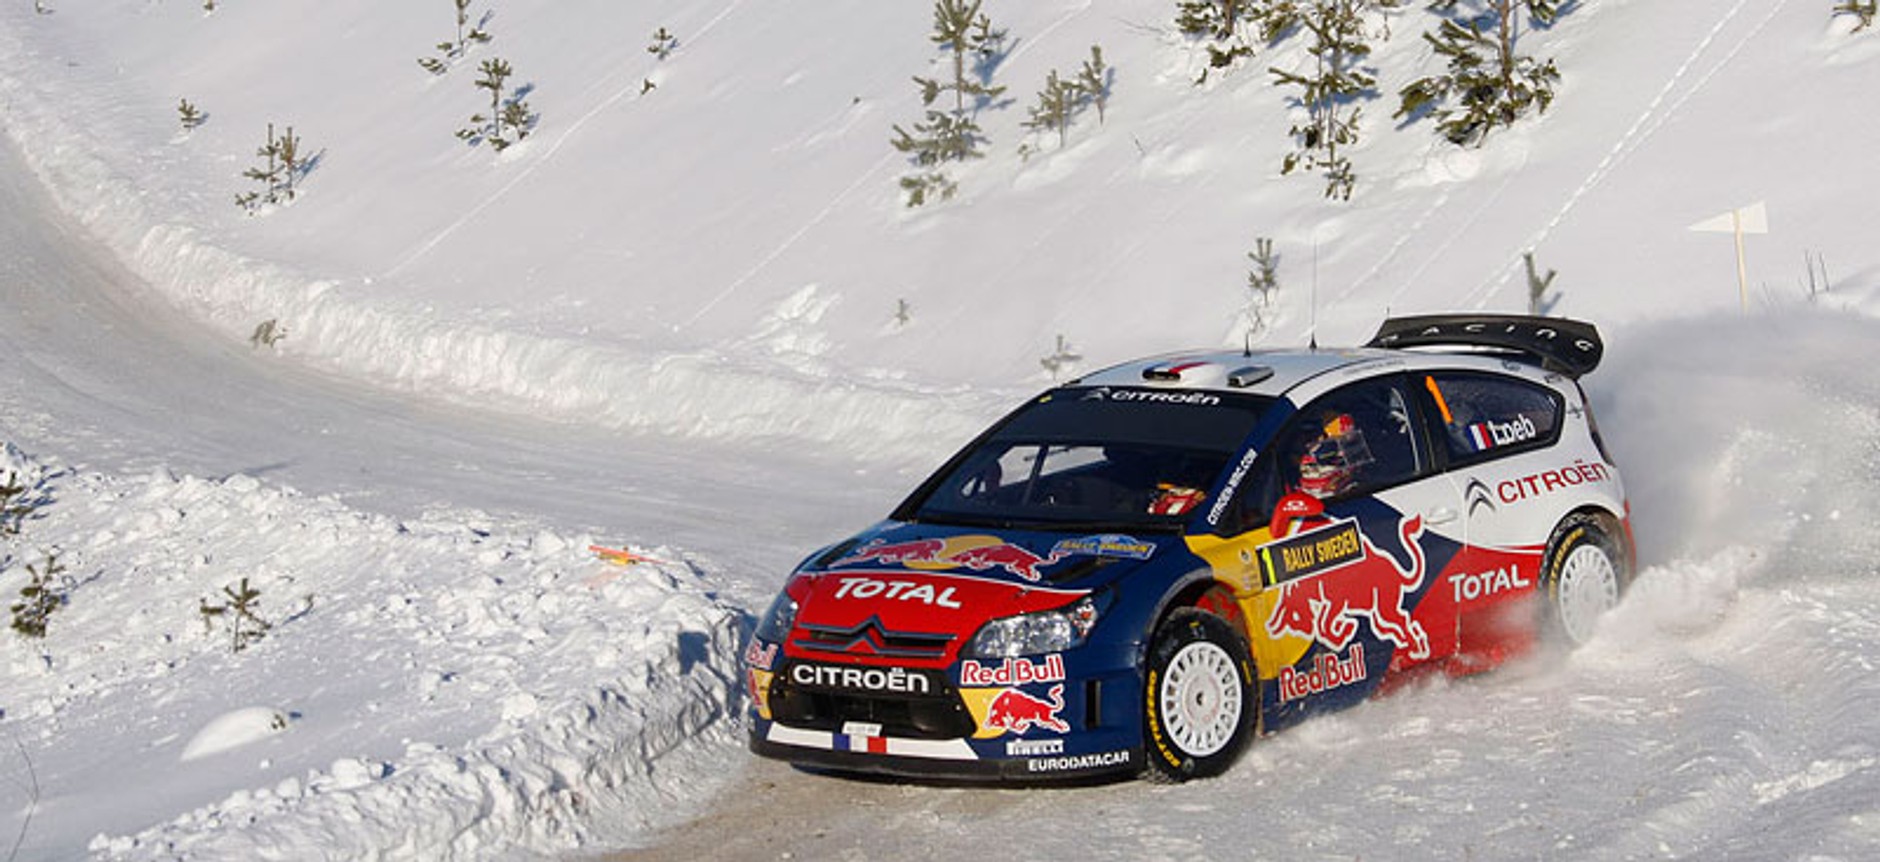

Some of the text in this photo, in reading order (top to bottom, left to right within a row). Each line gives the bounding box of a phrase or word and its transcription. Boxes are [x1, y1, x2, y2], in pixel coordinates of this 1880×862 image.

[1282, 544, 1315, 573] RALLY
[1315, 527, 1360, 563] SWEDEN
[834, 577, 962, 609] TOTAL
[1448, 564, 1530, 603] TOTAL
[793, 664, 929, 693] CITROËN
[961, 653, 1066, 686] Red Bull
[1280, 641, 1366, 702] Red Bull
[1029, 751, 1130, 772] EURODATACAR
